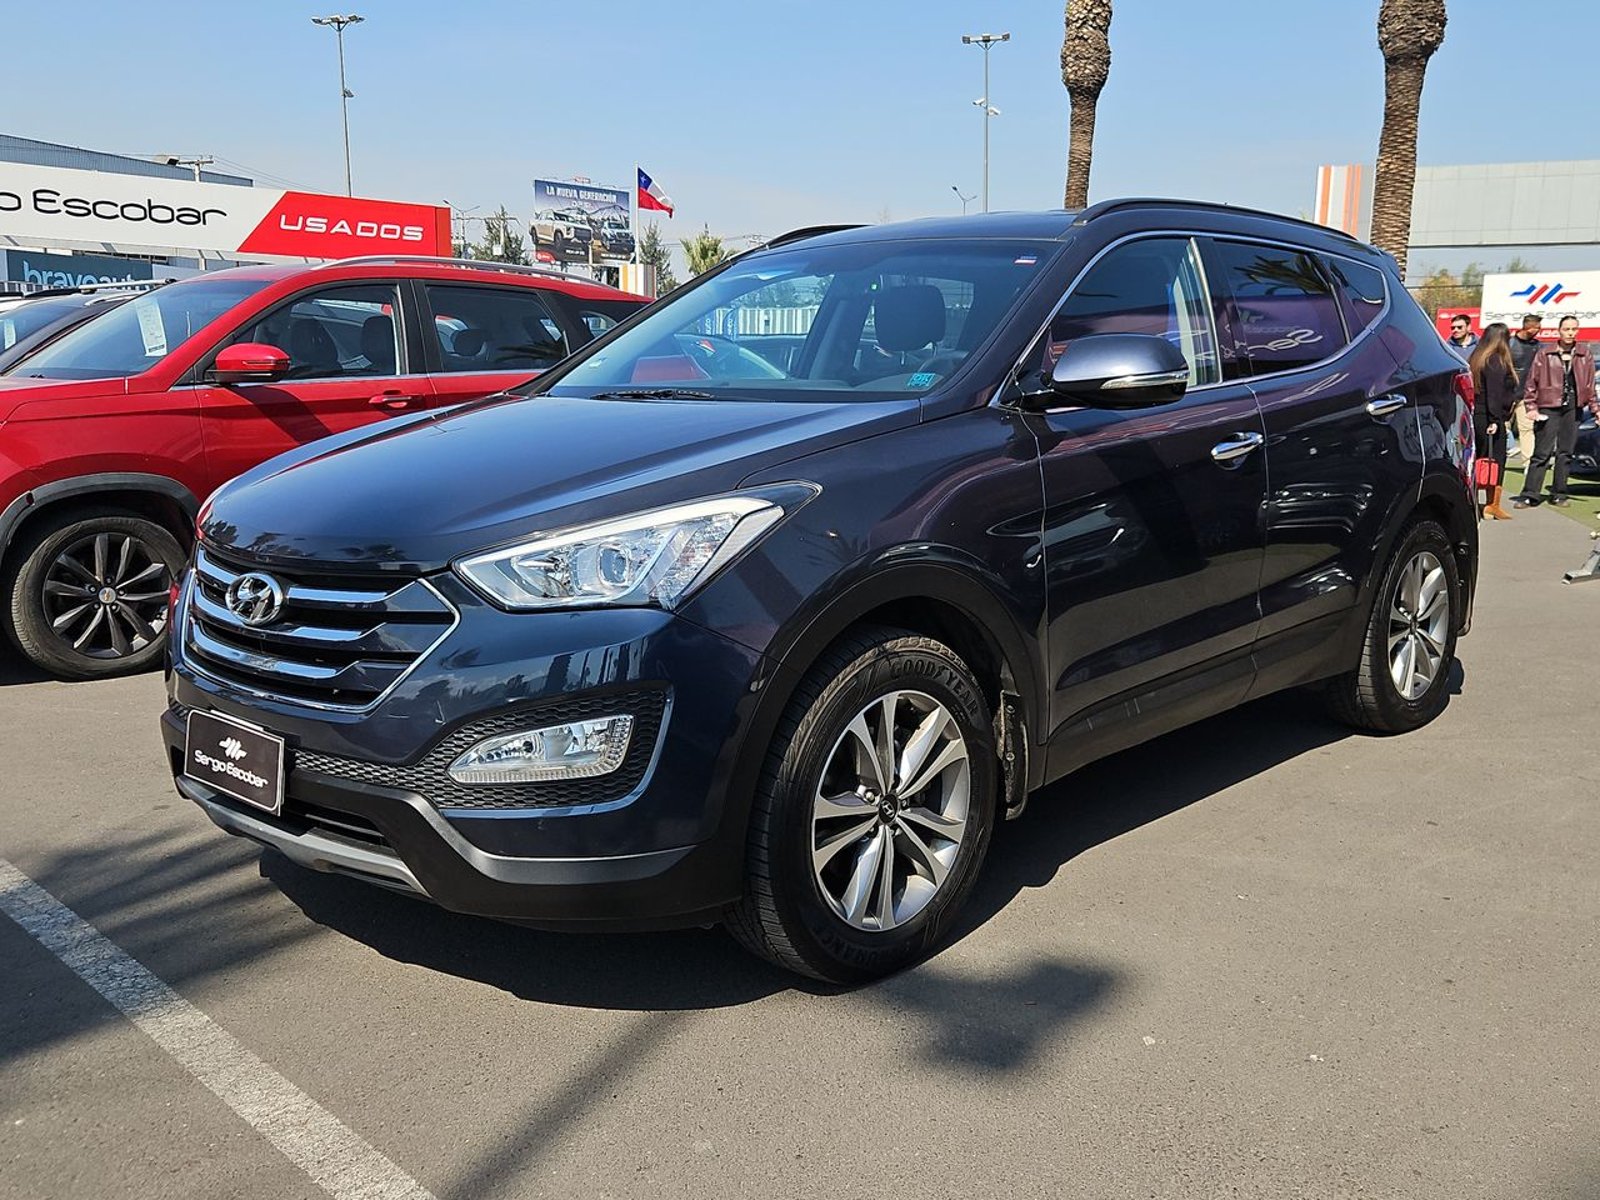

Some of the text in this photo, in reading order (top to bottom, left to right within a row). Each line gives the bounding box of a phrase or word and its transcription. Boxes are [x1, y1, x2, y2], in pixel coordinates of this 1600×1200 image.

[33, 189, 227, 226] Escobar
[546, 185, 555, 195] LA
[557, 187, 578, 199] NUEVA
[280, 214, 423, 241] USADOS
[890, 660, 978, 715] GOODYEAR
[194, 751, 268, 788] Sergo Escobar
